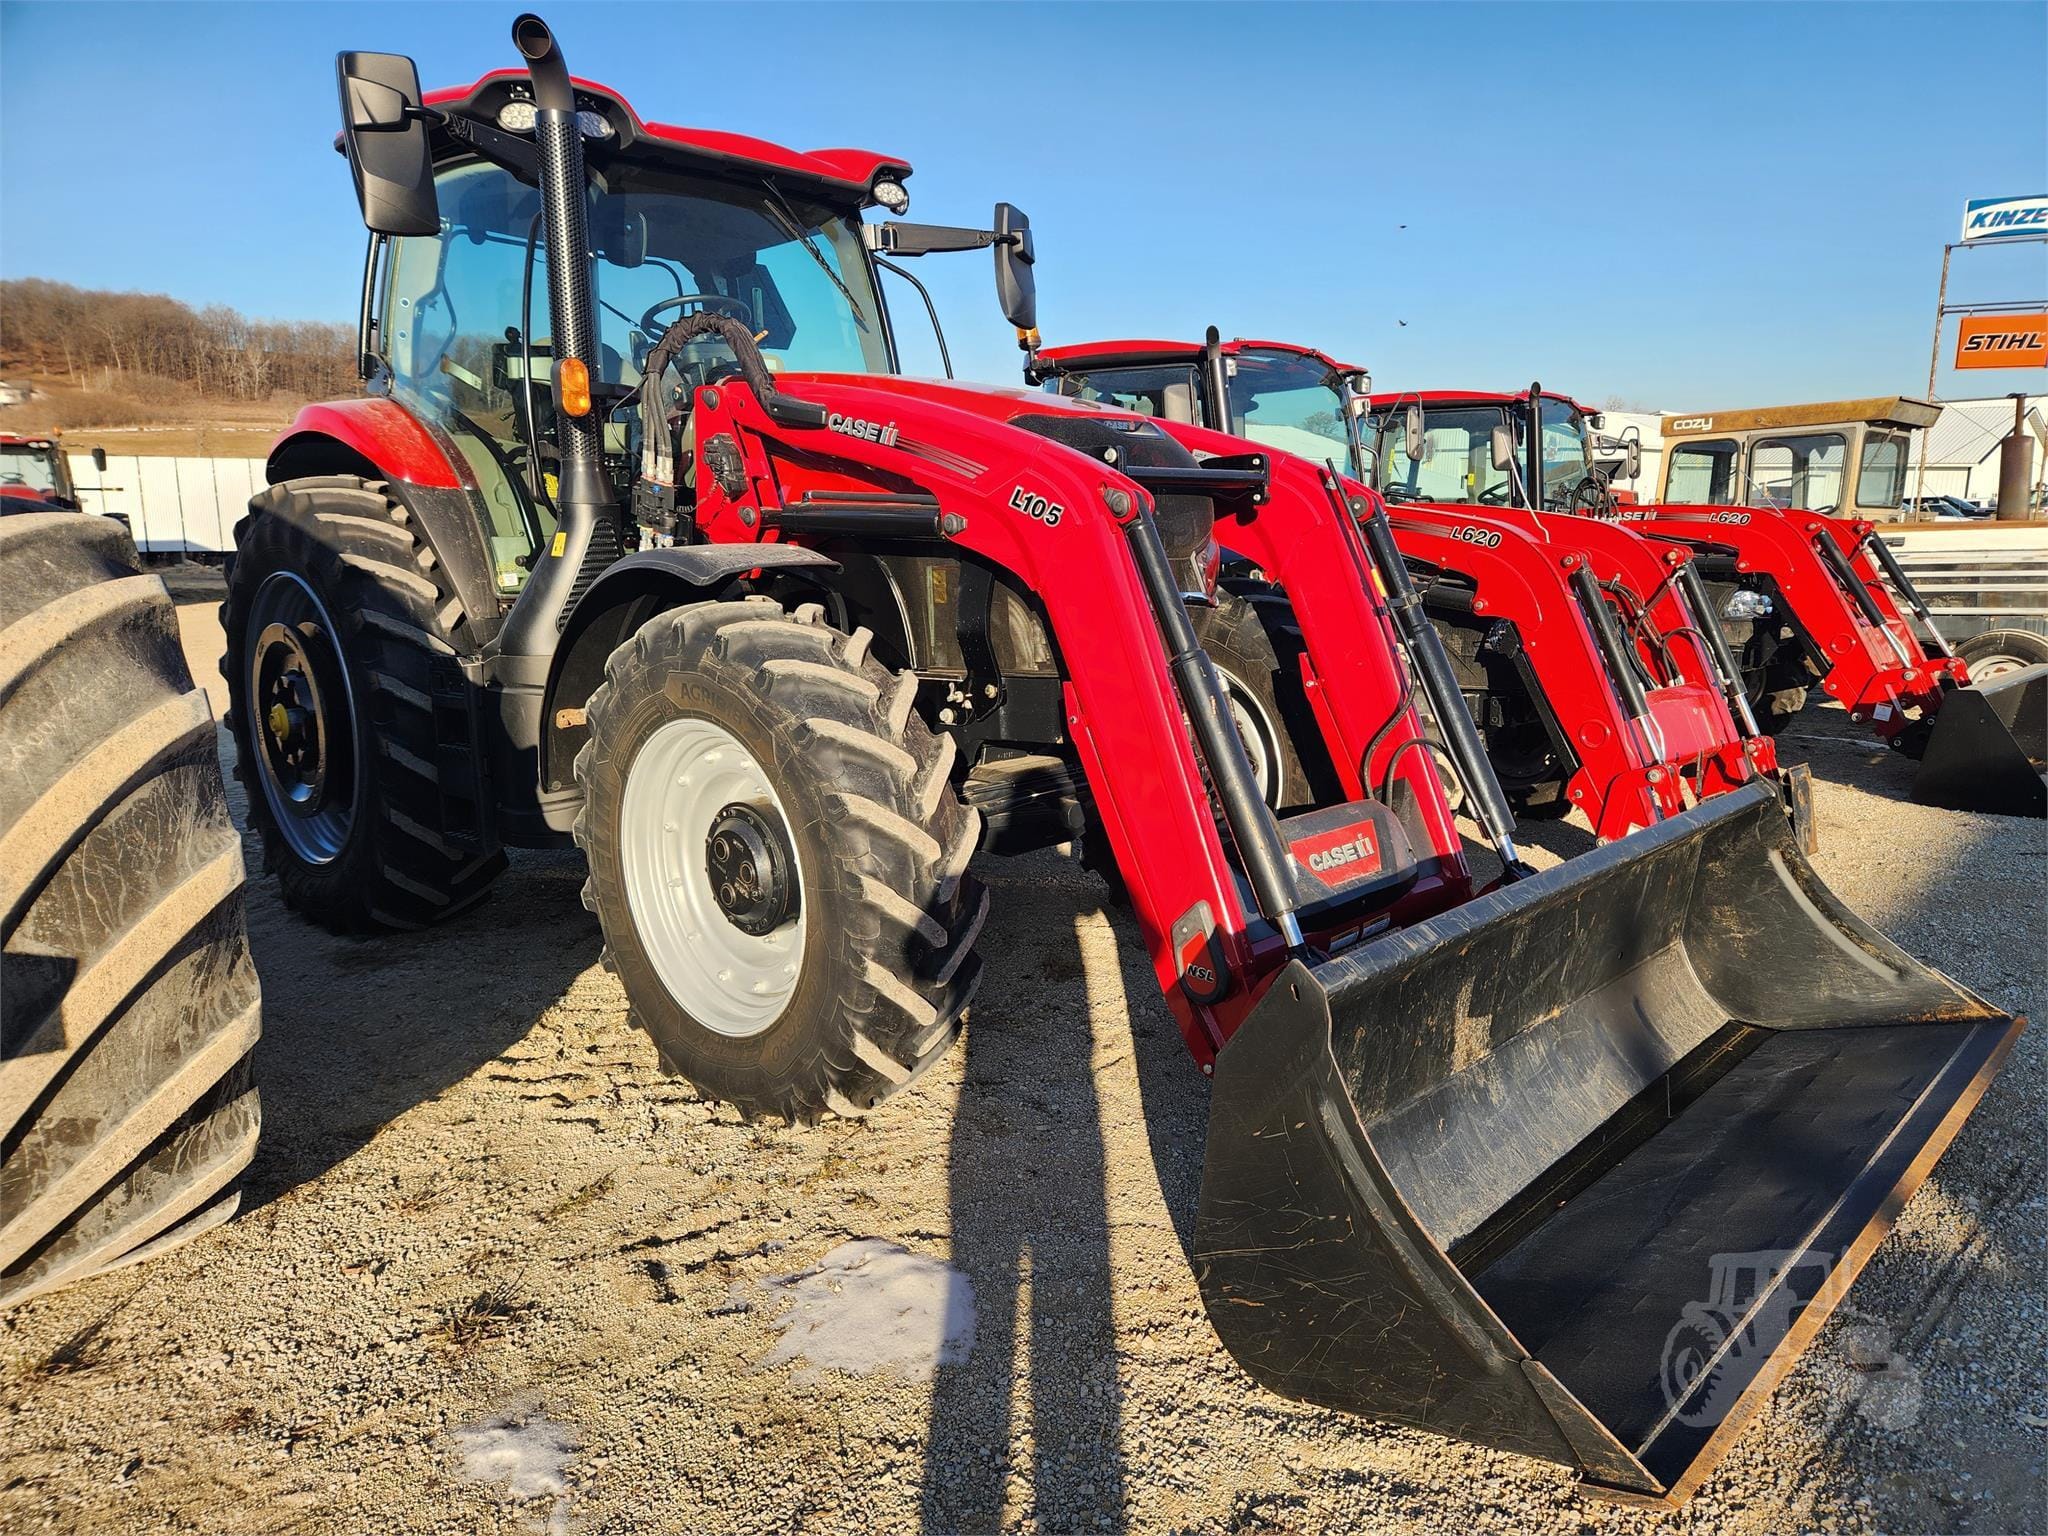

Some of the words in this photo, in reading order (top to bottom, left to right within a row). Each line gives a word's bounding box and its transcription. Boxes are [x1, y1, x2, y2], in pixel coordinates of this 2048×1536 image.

[1969, 207, 2048, 229] KINZE
[1963, 332, 2044, 351] STIHL
[828, 413, 880, 442] CASE
[1008, 485, 1065, 528] L105
[1708, 511, 1752, 527] L620
[1449, 525, 1503, 549] L620
[1308, 842, 1358, 872] CASE
[1186, 962, 1217, 983] NSL
